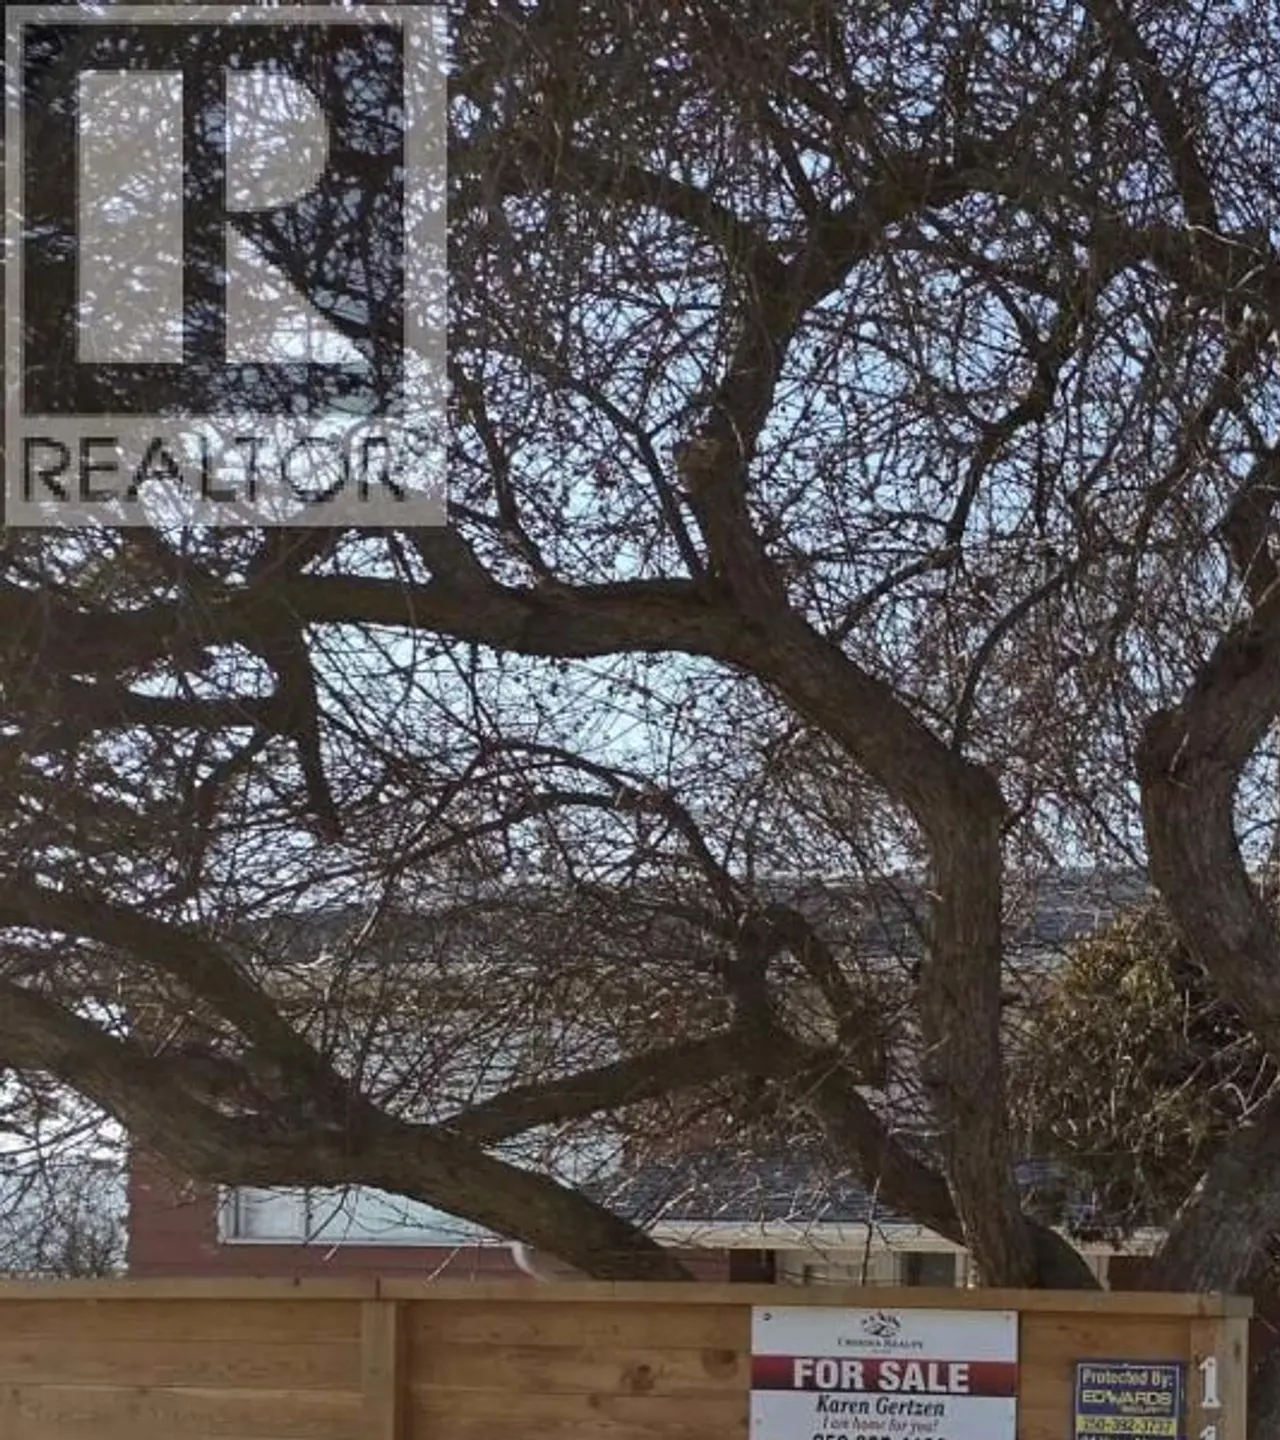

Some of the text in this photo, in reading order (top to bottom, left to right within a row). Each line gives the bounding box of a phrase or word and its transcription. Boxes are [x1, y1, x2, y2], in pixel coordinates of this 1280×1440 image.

[793, 1358, 970, 1394] FOR SALE
[1082, 1368, 1149, 1386] Protected
[815, 1394, 946, 1417] Karen Gertzen
[1082, 1389, 1173, 1406] EDWARDS
